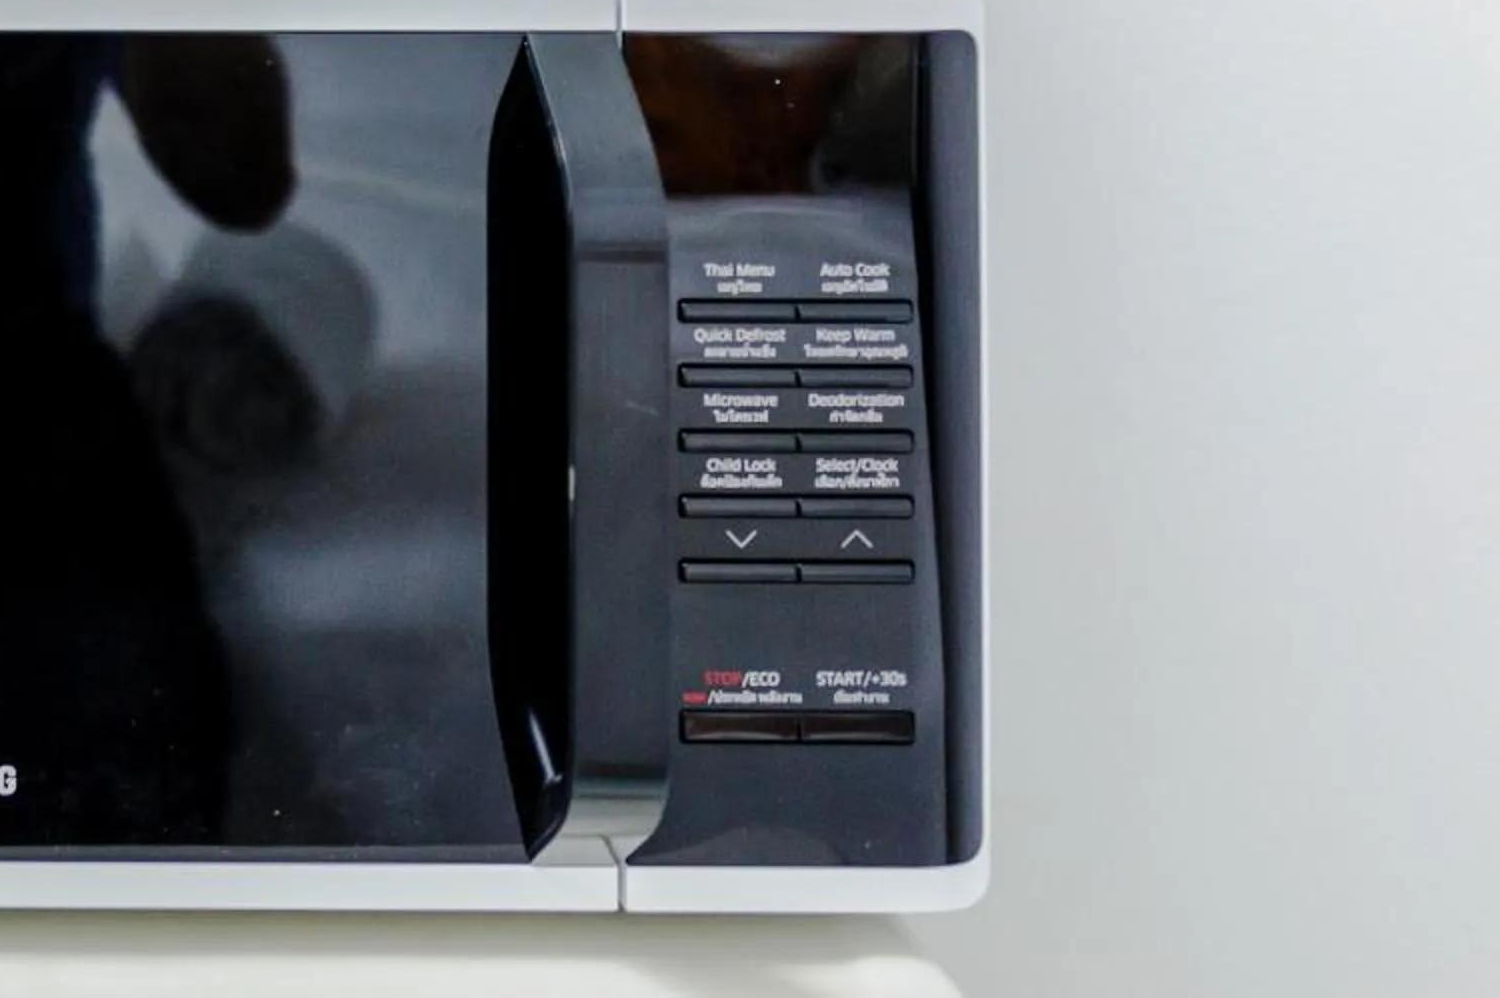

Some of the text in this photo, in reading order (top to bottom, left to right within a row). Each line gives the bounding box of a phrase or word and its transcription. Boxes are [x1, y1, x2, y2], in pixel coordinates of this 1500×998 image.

[703, 263, 776, 277] Thai Menu
[819, 263, 891, 277] Auto Cook
[694, 328, 787, 343] Quick Defrost
[815, 328, 896, 343] Keep Warm
[703, 394, 779, 408] Microwave
[808, 393, 905, 408] Deodorization
[706, 458, 777, 473] Child Lock
[815, 458, 899, 474] Select/Clock
[815, 671, 908, 687] START/+30s
